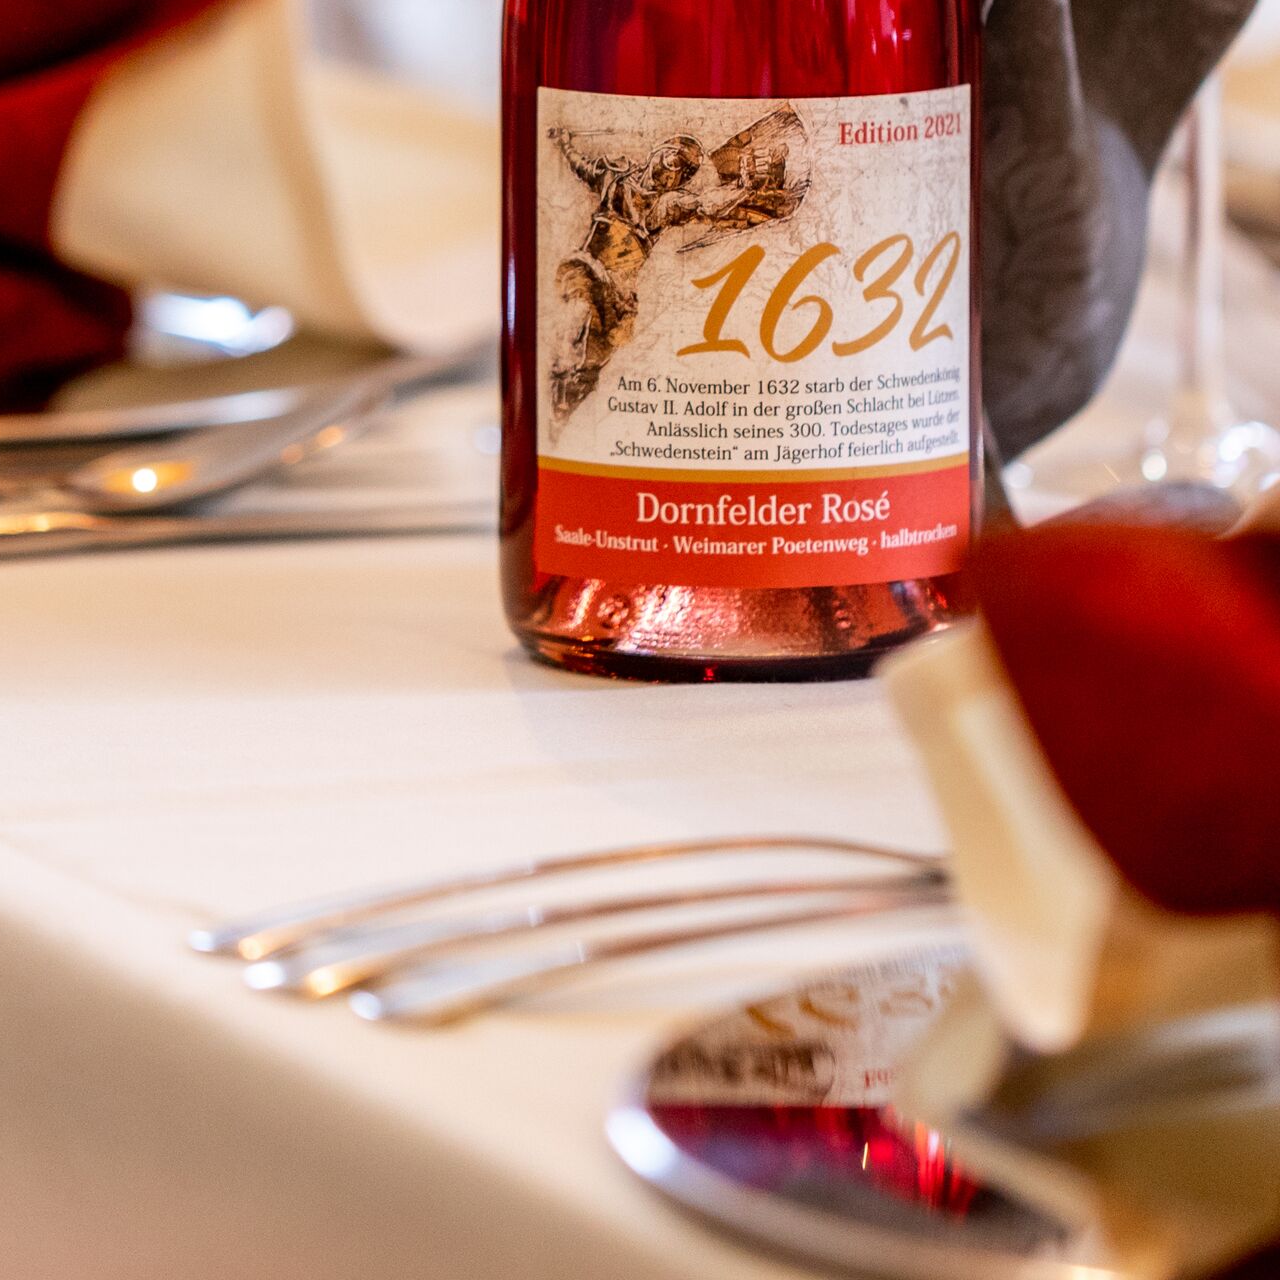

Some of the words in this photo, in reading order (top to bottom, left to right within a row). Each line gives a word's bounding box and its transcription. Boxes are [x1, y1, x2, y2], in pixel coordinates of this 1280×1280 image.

[838, 120, 918, 145] Edition
[924, 113, 961, 139] 2021
[676, 230, 962, 363] 1632
[617, 376, 642, 392] Am
[647, 377, 661, 393] 6.
[666, 378, 751, 395] November
[758, 379, 800, 395] 1632
[805, 377, 845, 394] starb
[849, 376, 873, 391] der
[877, 367, 961, 390] Schwedenkönig
[608, 396, 658, 414] Gustav
[663, 400, 679, 415] II.
[683, 401, 729, 417] Adolf
[732, 402, 748, 417] in
[753, 401, 781, 417] der
[785, 400, 842, 420] großen
[846, 394, 905, 414] Schlacht
[908, 391, 925, 409] bei
[647, 421, 728, 439] Anlässlich
[733, 424, 784, 439] seines
[790, 423, 826, 438] 300.
[830, 419, 908, 438] Todestages
[912, 410, 944, 429] wurde
[946, 408, 960, 424] der
[609, 441, 738, 460] „Schwedenstein“
[744, 449, 769, 461] am
[774, 442, 845, 465] Jägerhof
[847, 438, 904, 458] feierlich
[636, 492, 813, 527] Dornfelder
[821, 490, 891, 524] Rosé
[554, 523, 659, 553] Saale-Unstrut
[673, 535, 767, 556] Weimarer
[771, 536, 870, 556] Poetenweg
[880, 522, 958, 549] halbtrocken
